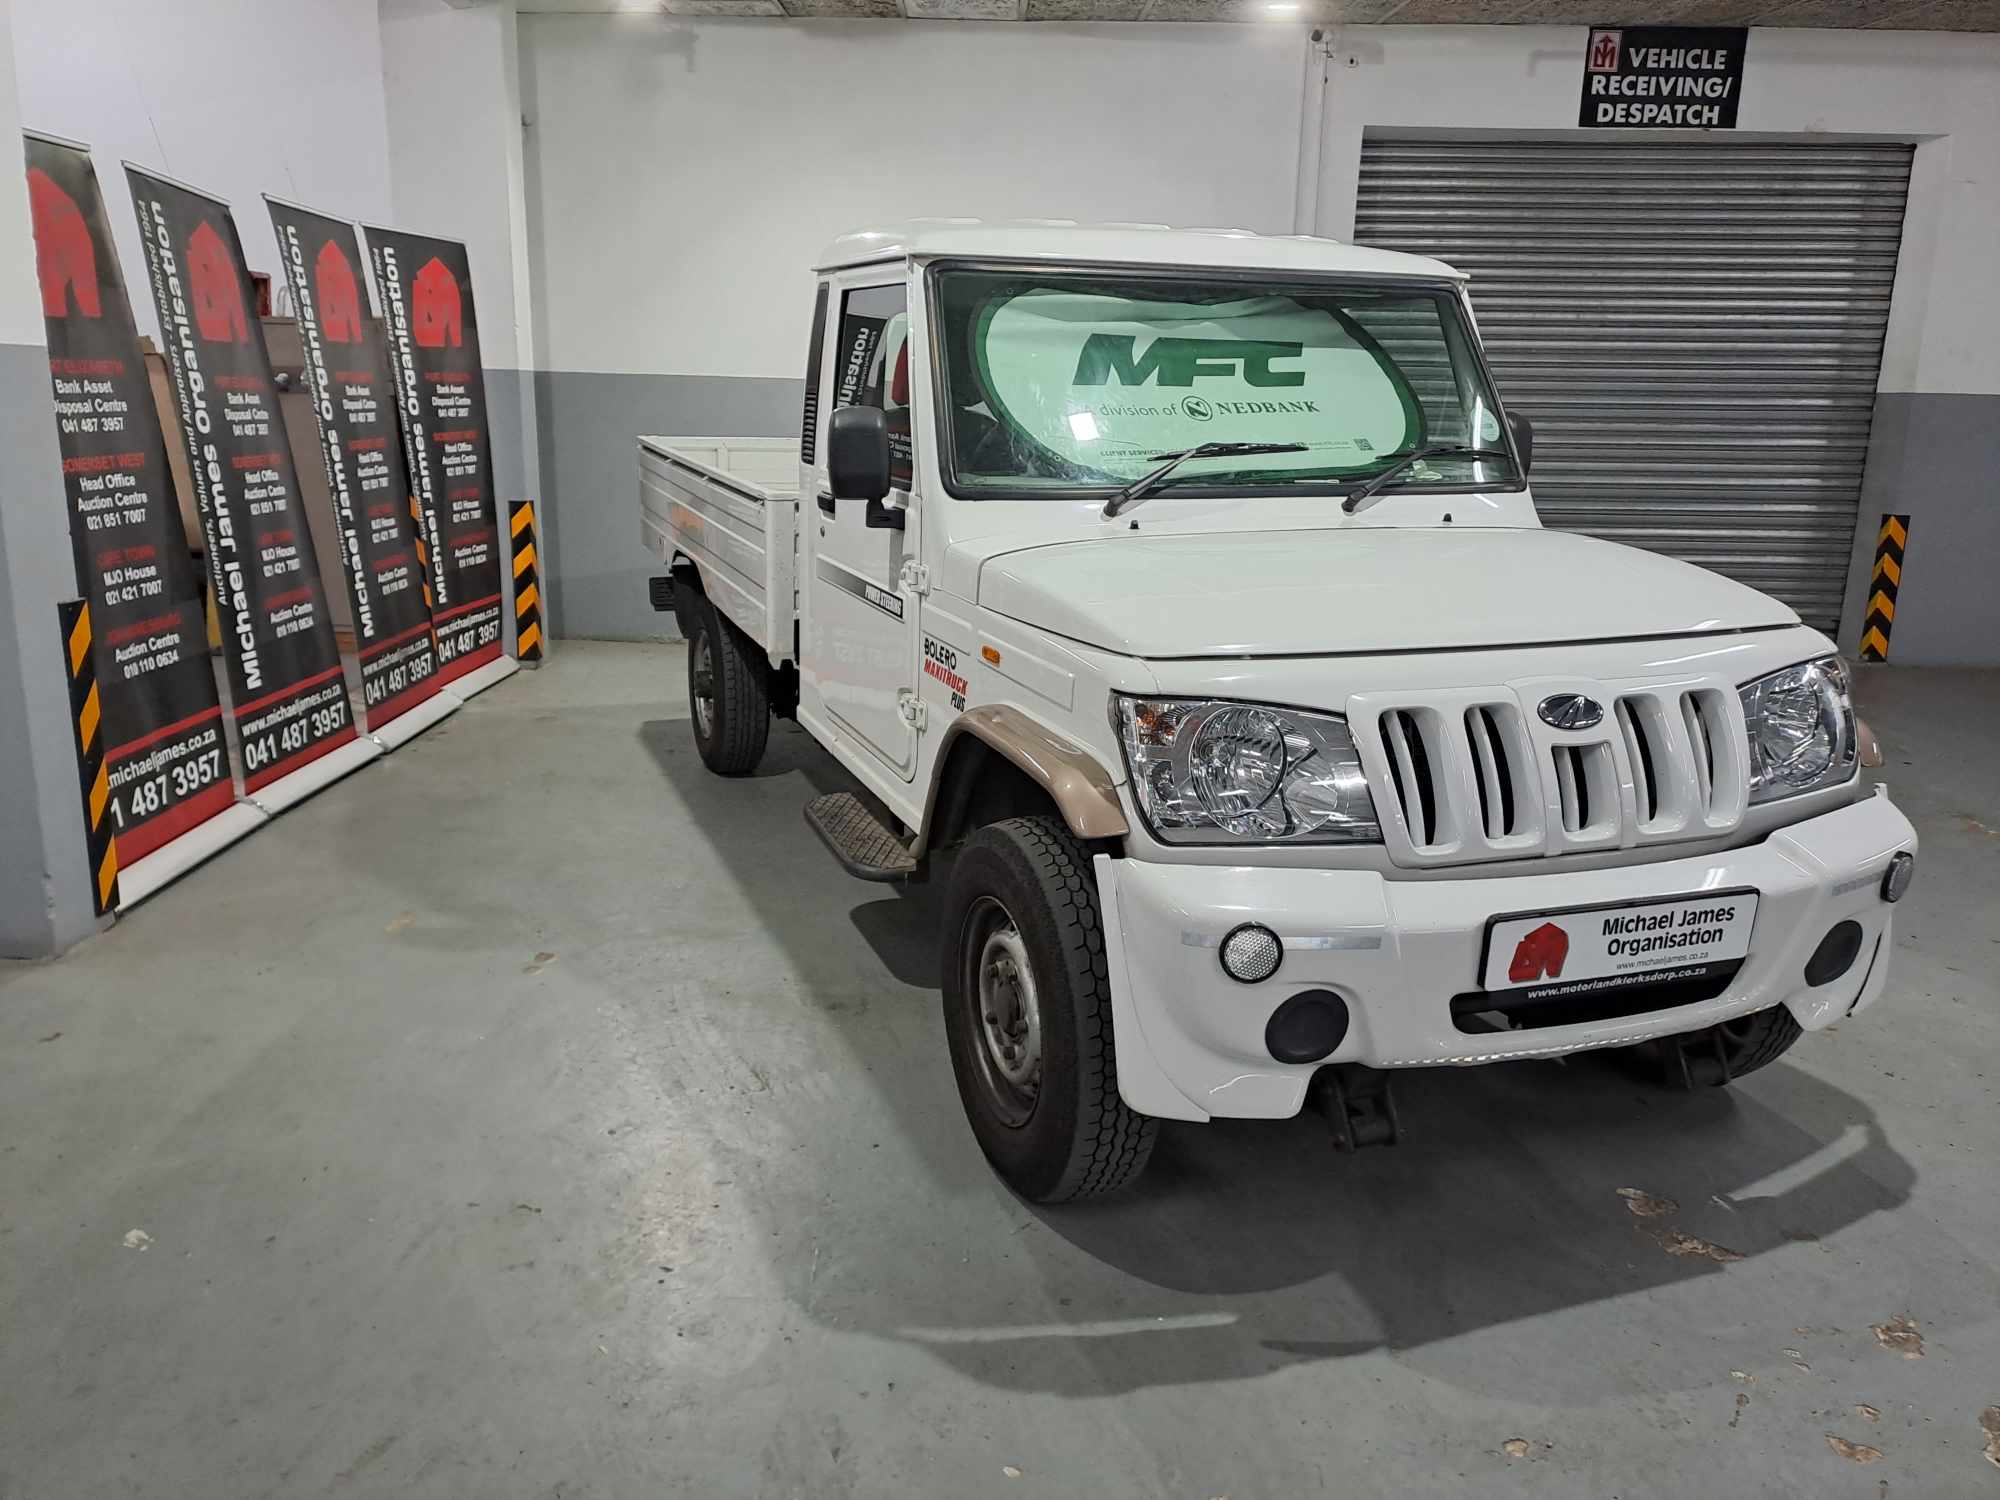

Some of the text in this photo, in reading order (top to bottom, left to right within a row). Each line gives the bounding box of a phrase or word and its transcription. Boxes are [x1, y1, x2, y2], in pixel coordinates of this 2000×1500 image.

[1629, 48, 1728, 70] VEHICLE
[1591, 75, 1732, 98] RECEIVING/
[1597, 103, 1720, 125] DESPATCH
[1072, 333, 1305, 387] MFC
[55, 379, 113, 394] Bank Asset
[94, 399, 128, 412] Centre
[1100, 402, 1177, 416] division of
[1216, 400, 1320, 415] NEDBANK
[80, 418, 98, 432] 487
[101, 417, 124, 431] 3957
[287, 225, 374, 638] Michael James Organisation
[384, 247, 447, 604] Michael James Organisation
[151, 201, 262, 690] Michael James Organisation
[80, 473, 136, 492] Head Office
[78, 492, 148, 512] Auction Centre
[104, 512, 121, 528] 851
[123, 509, 146, 524] 7007
[104, 565, 157, 586] MJO House
[122, 586, 138, 601] 421
[140, 580, 163, 597] 7007
[116, 632, 180, 663] Auction Centre
[438, 620, 500, 662] 041 487 3957
[924, 638, 957, 670] BOLERO
[365, 652, 432, 705] 041 487 3957
[924, 658, 968, 696] MAXITRUCK
[950, 691, 966, 712] PLUS
[245, 701, 345, 770] 041 487 3957
[108, 728, 216, 789] .michaeljames.co.za
[131, 774, 168, 816] 487
[172, 749, 220, 796] 3957
[1602, 907, 1735, 936] Michael James
[1607, 927, 1724, 956] Organisation
